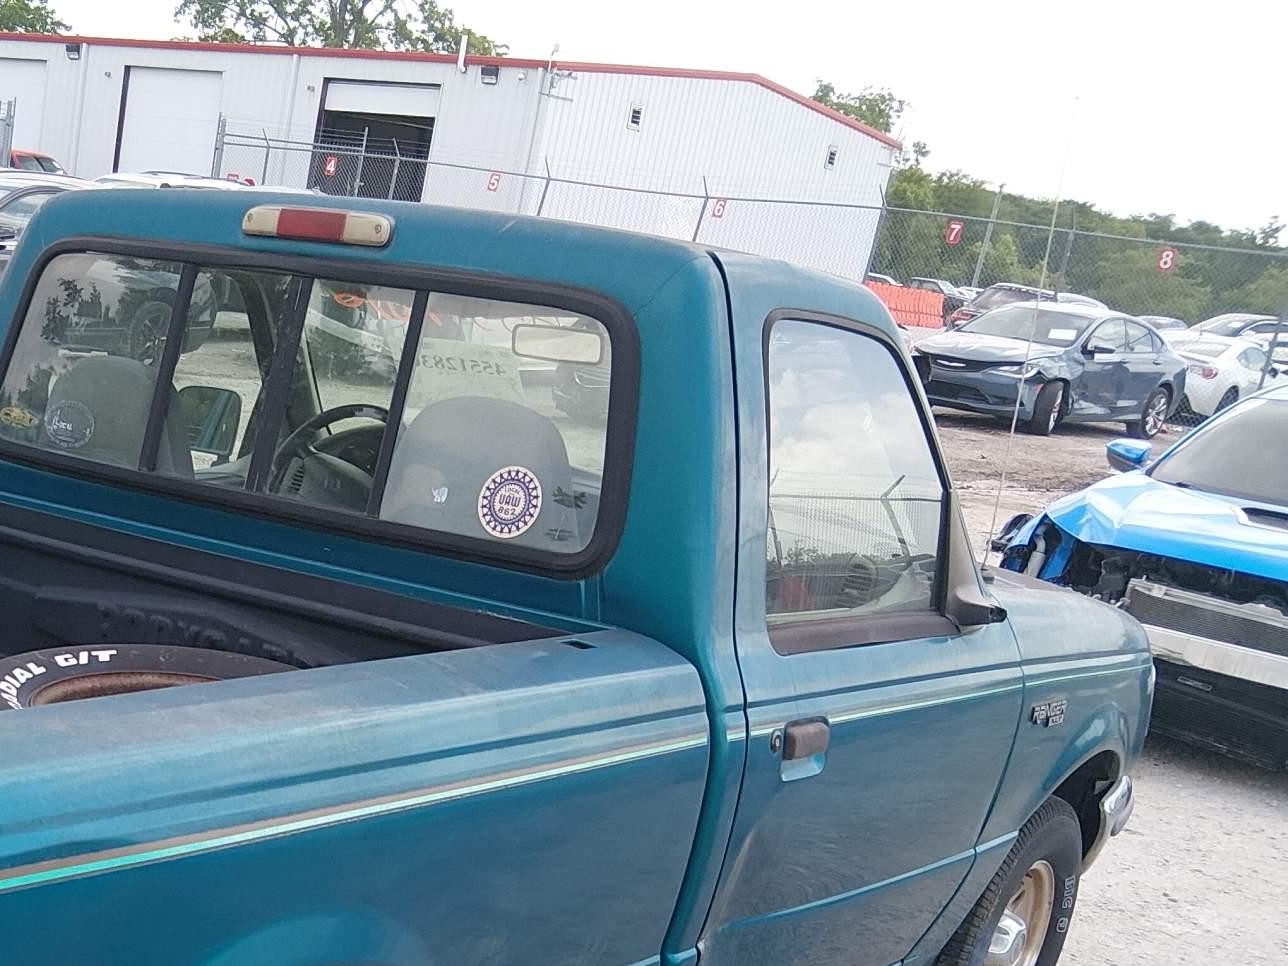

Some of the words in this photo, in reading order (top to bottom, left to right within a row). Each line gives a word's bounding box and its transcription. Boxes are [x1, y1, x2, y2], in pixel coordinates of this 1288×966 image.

[326, 159, 336, 173] 4
[489, 176, 499, 190] 5
[714, 201, 724, 217] 6
[949, 224, 961, 241] 7
[1160, 251, 1173, 269] 8
[498, 494, 521, 507] UAW
[497, 506, 518, 516] 862
[55, 650, 118, 667] G/T
